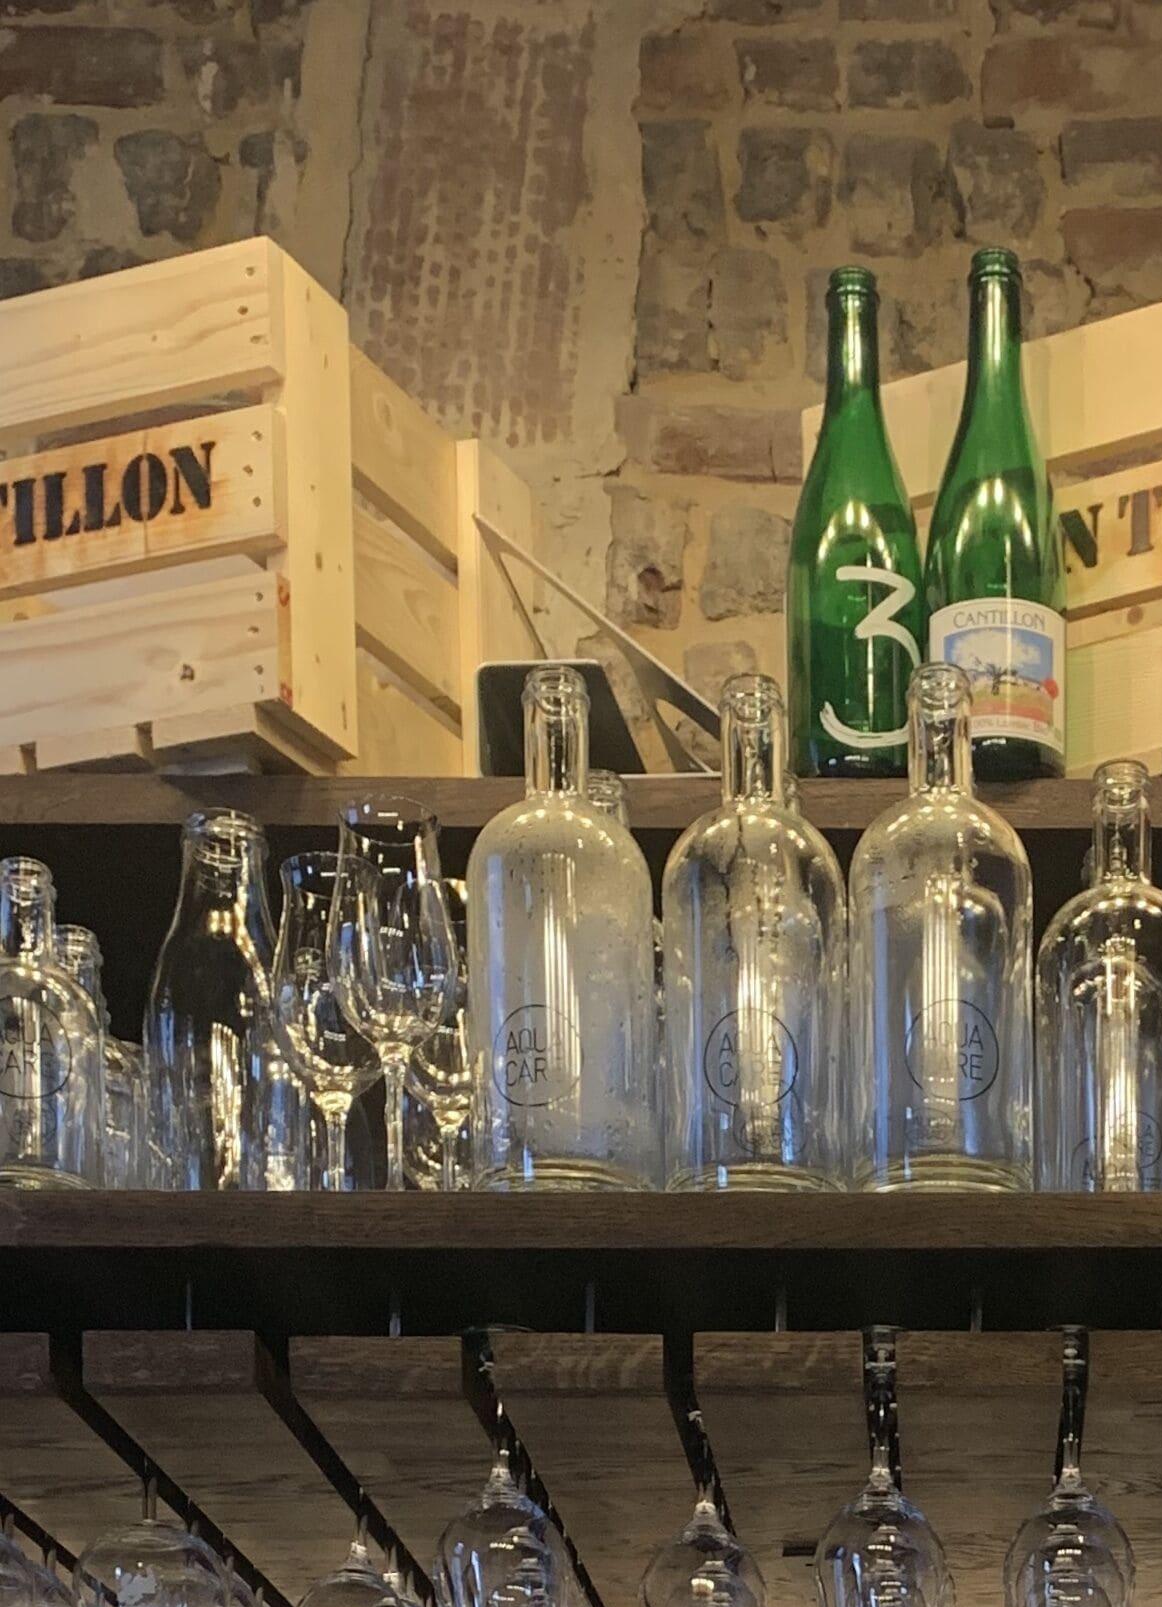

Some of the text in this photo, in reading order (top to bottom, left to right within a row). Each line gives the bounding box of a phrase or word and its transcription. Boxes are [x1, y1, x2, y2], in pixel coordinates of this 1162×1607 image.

[0, 441, 216, 546] ILLON
[953, 609, 1046, 632] CANTILLON
[819, 565, 922, 749] 3
[505, 1027, 547, 1055] AQU
[504, 1057, 548, 1087] CAR
